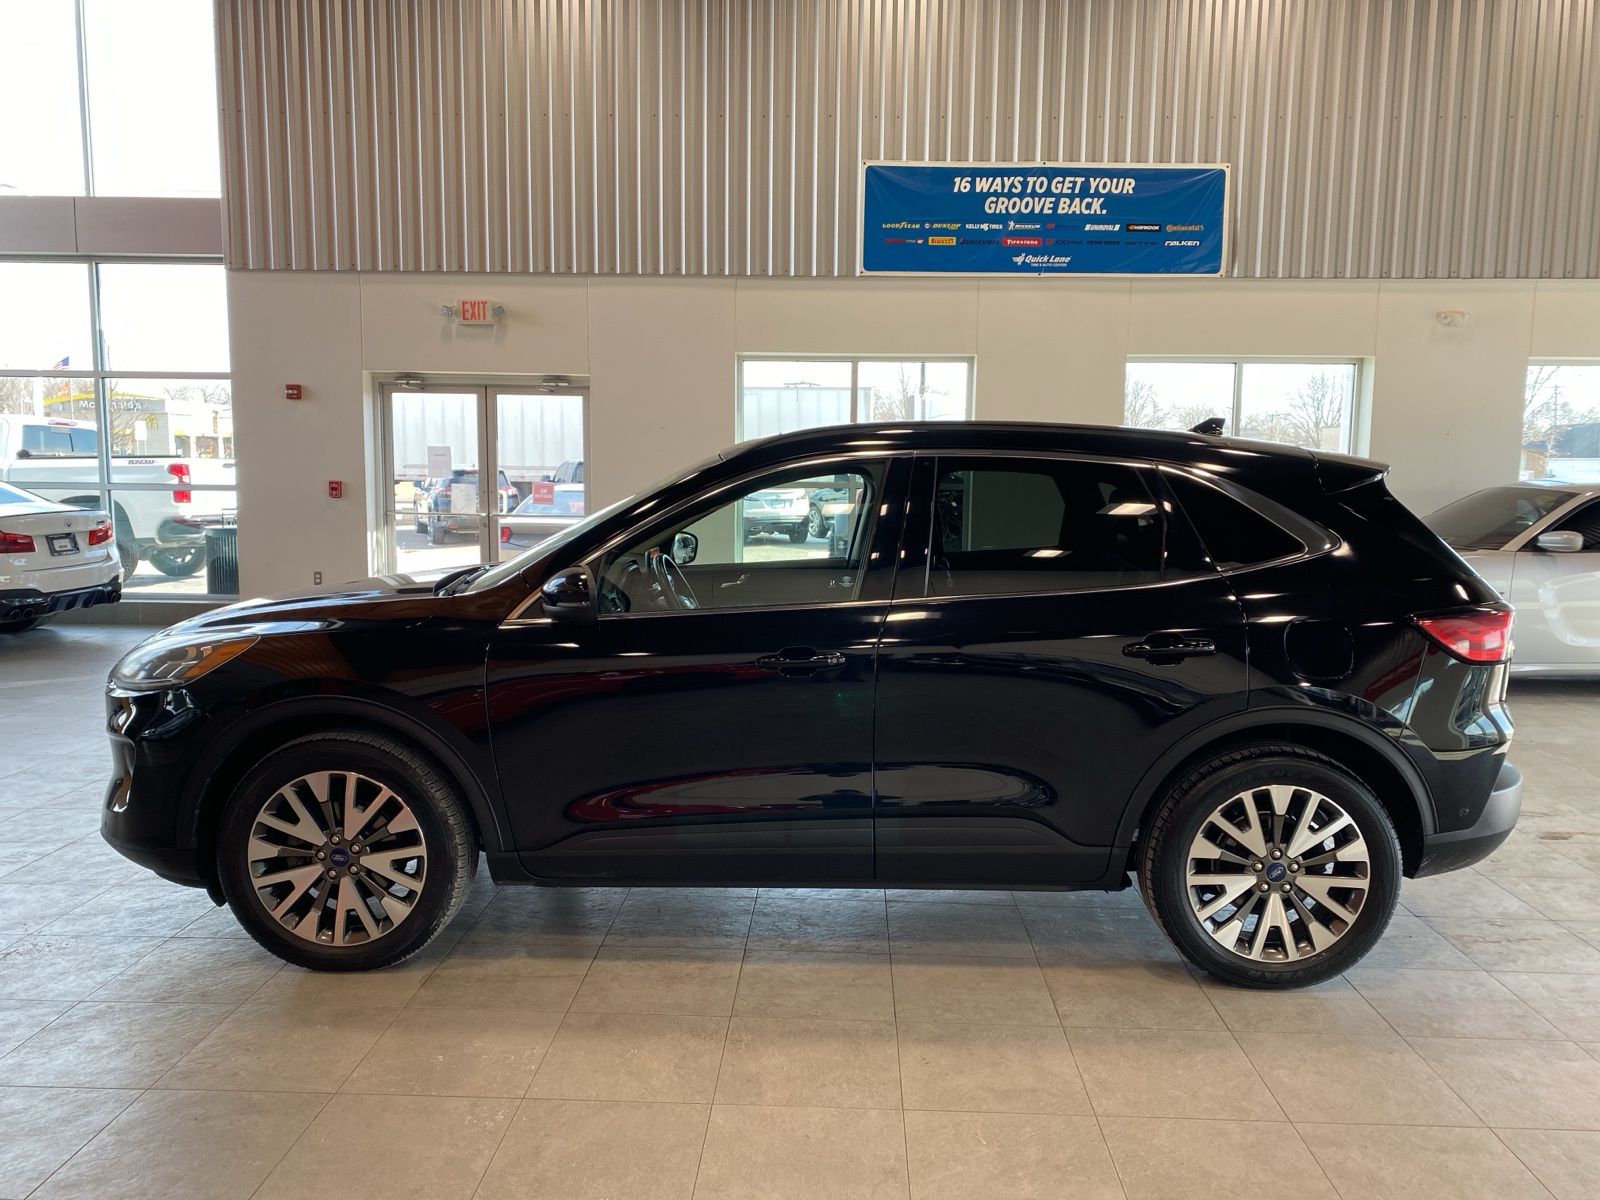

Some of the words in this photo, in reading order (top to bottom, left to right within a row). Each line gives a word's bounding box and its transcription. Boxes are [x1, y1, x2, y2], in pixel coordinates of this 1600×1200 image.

[953, 176, 972, 193] 16
[975, 176, 1024, 193] WAYS
[1026, 176, 1048, 193] TO
[1051, 176, 1086, 194] GET
[1089, 177, 1136, 194] YOUR
[984, 196, 1056, 214] GROOVE
[1057, 197, 1107, 215] BACK.
[882, 221, 921, 230] GOODYEAR
[1166, 224, 1200, 232] Continental
[1025, 255, 1049, 264] Quick
[1049, 255, 1071, 263] Lane
[461, 301, 488, 321] EXIT
[79, 399, 142, 410] Mcnald's
